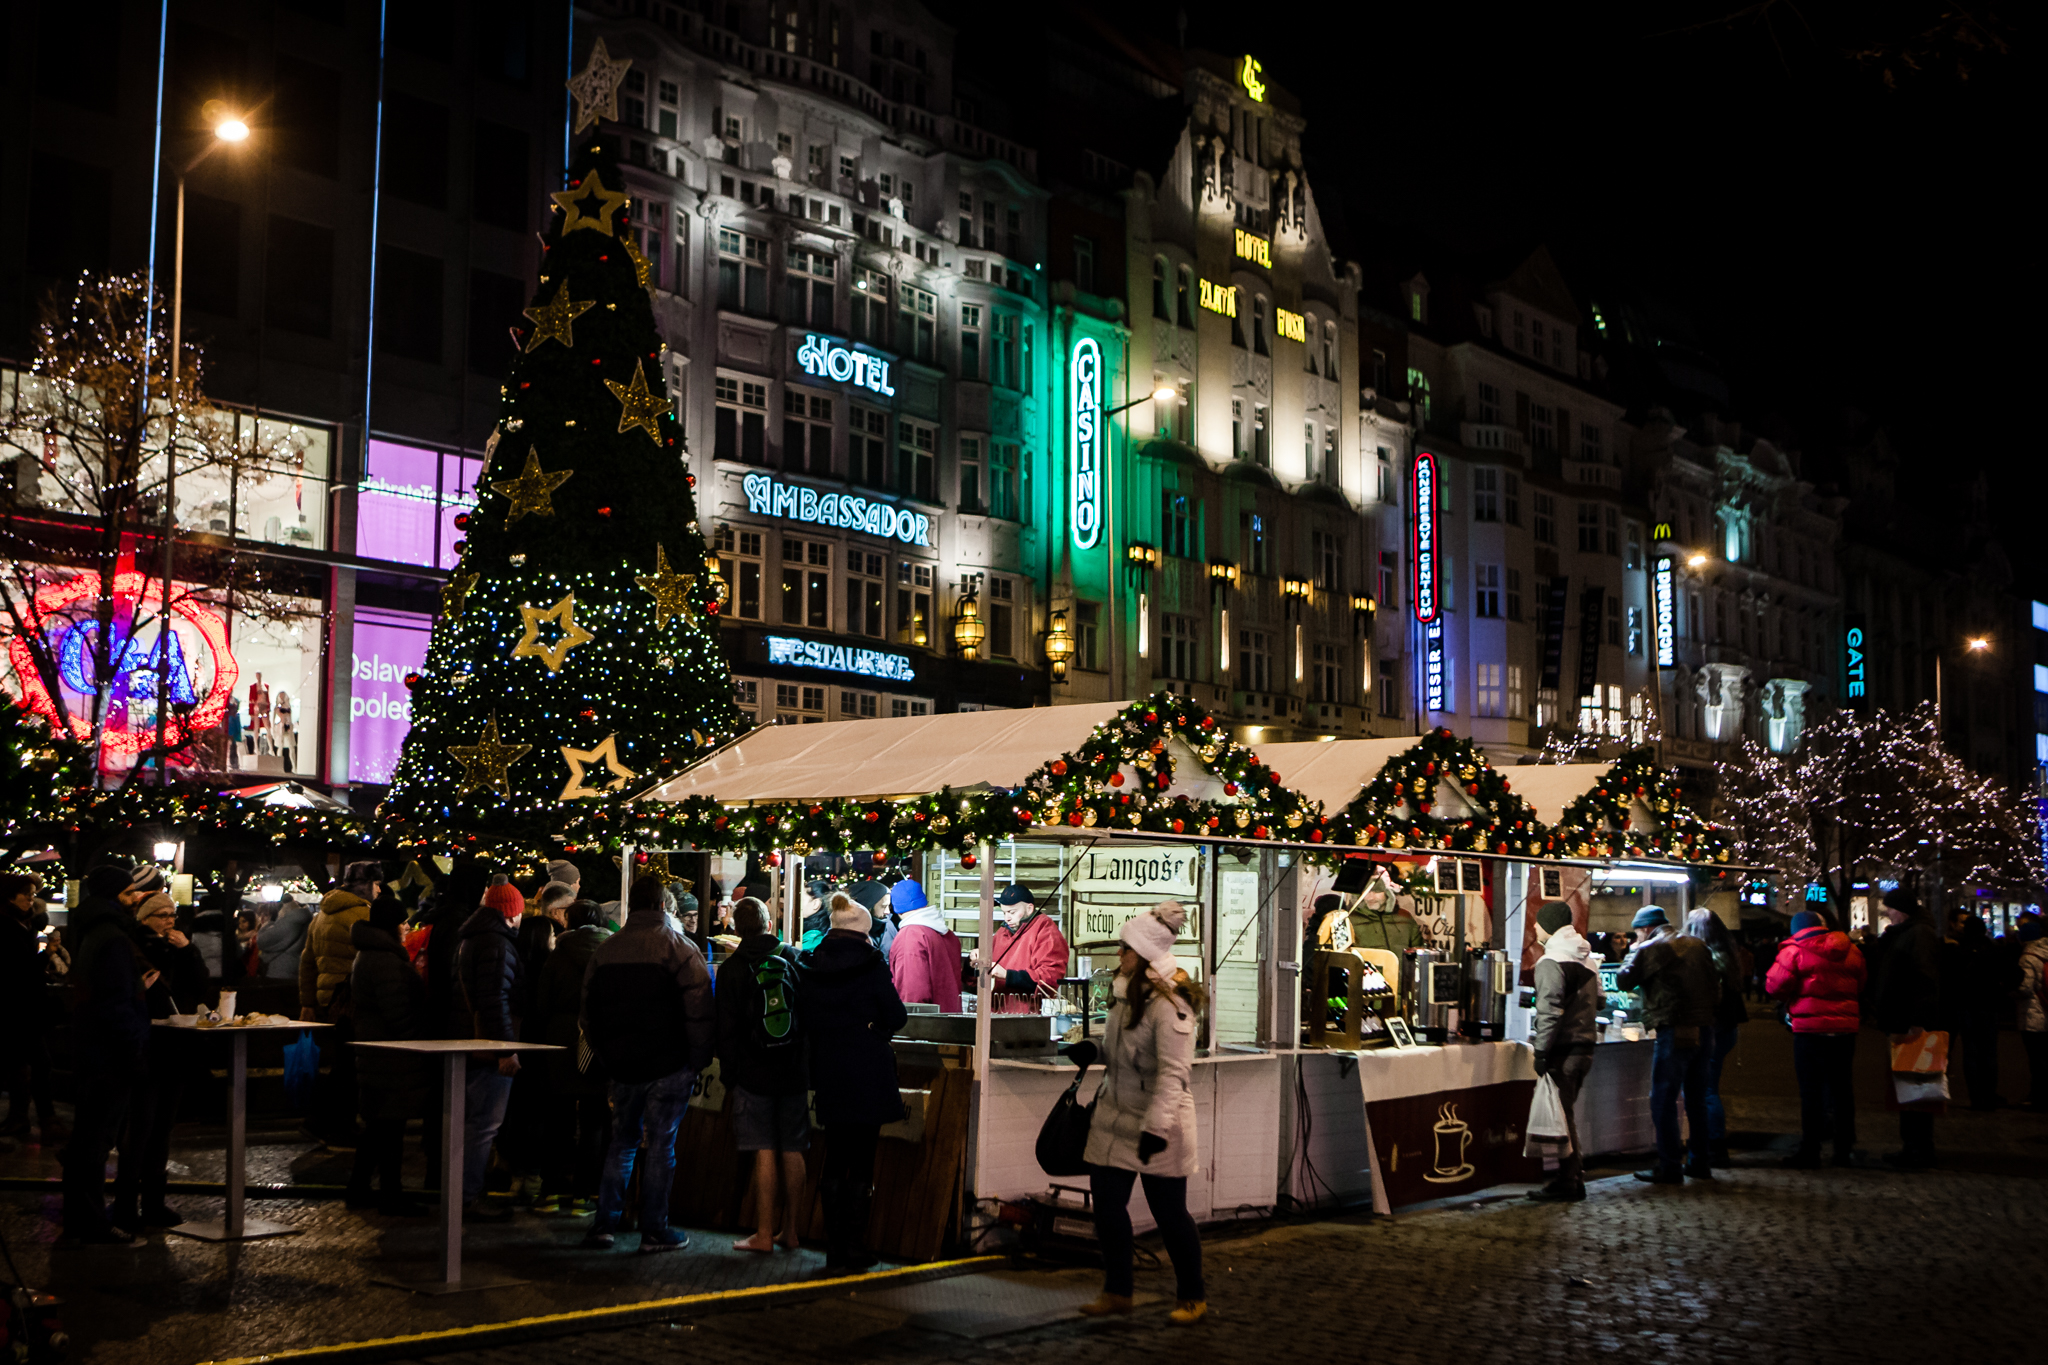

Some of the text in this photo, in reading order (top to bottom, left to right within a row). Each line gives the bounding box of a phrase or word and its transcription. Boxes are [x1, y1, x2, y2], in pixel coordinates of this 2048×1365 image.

[1235, 228, 1272, 269] HOTEL
[798, 335, 895, 397] HOTEL
[1077, 354, 1094, 531] CASINO
[743, 474, 929, 547] AMBASSADOR
[1419, 552, 1433, 618] CENTRUM
[1847, 627, 1865, 698] GATE
[1415, 898, 1443, 917] CUT
